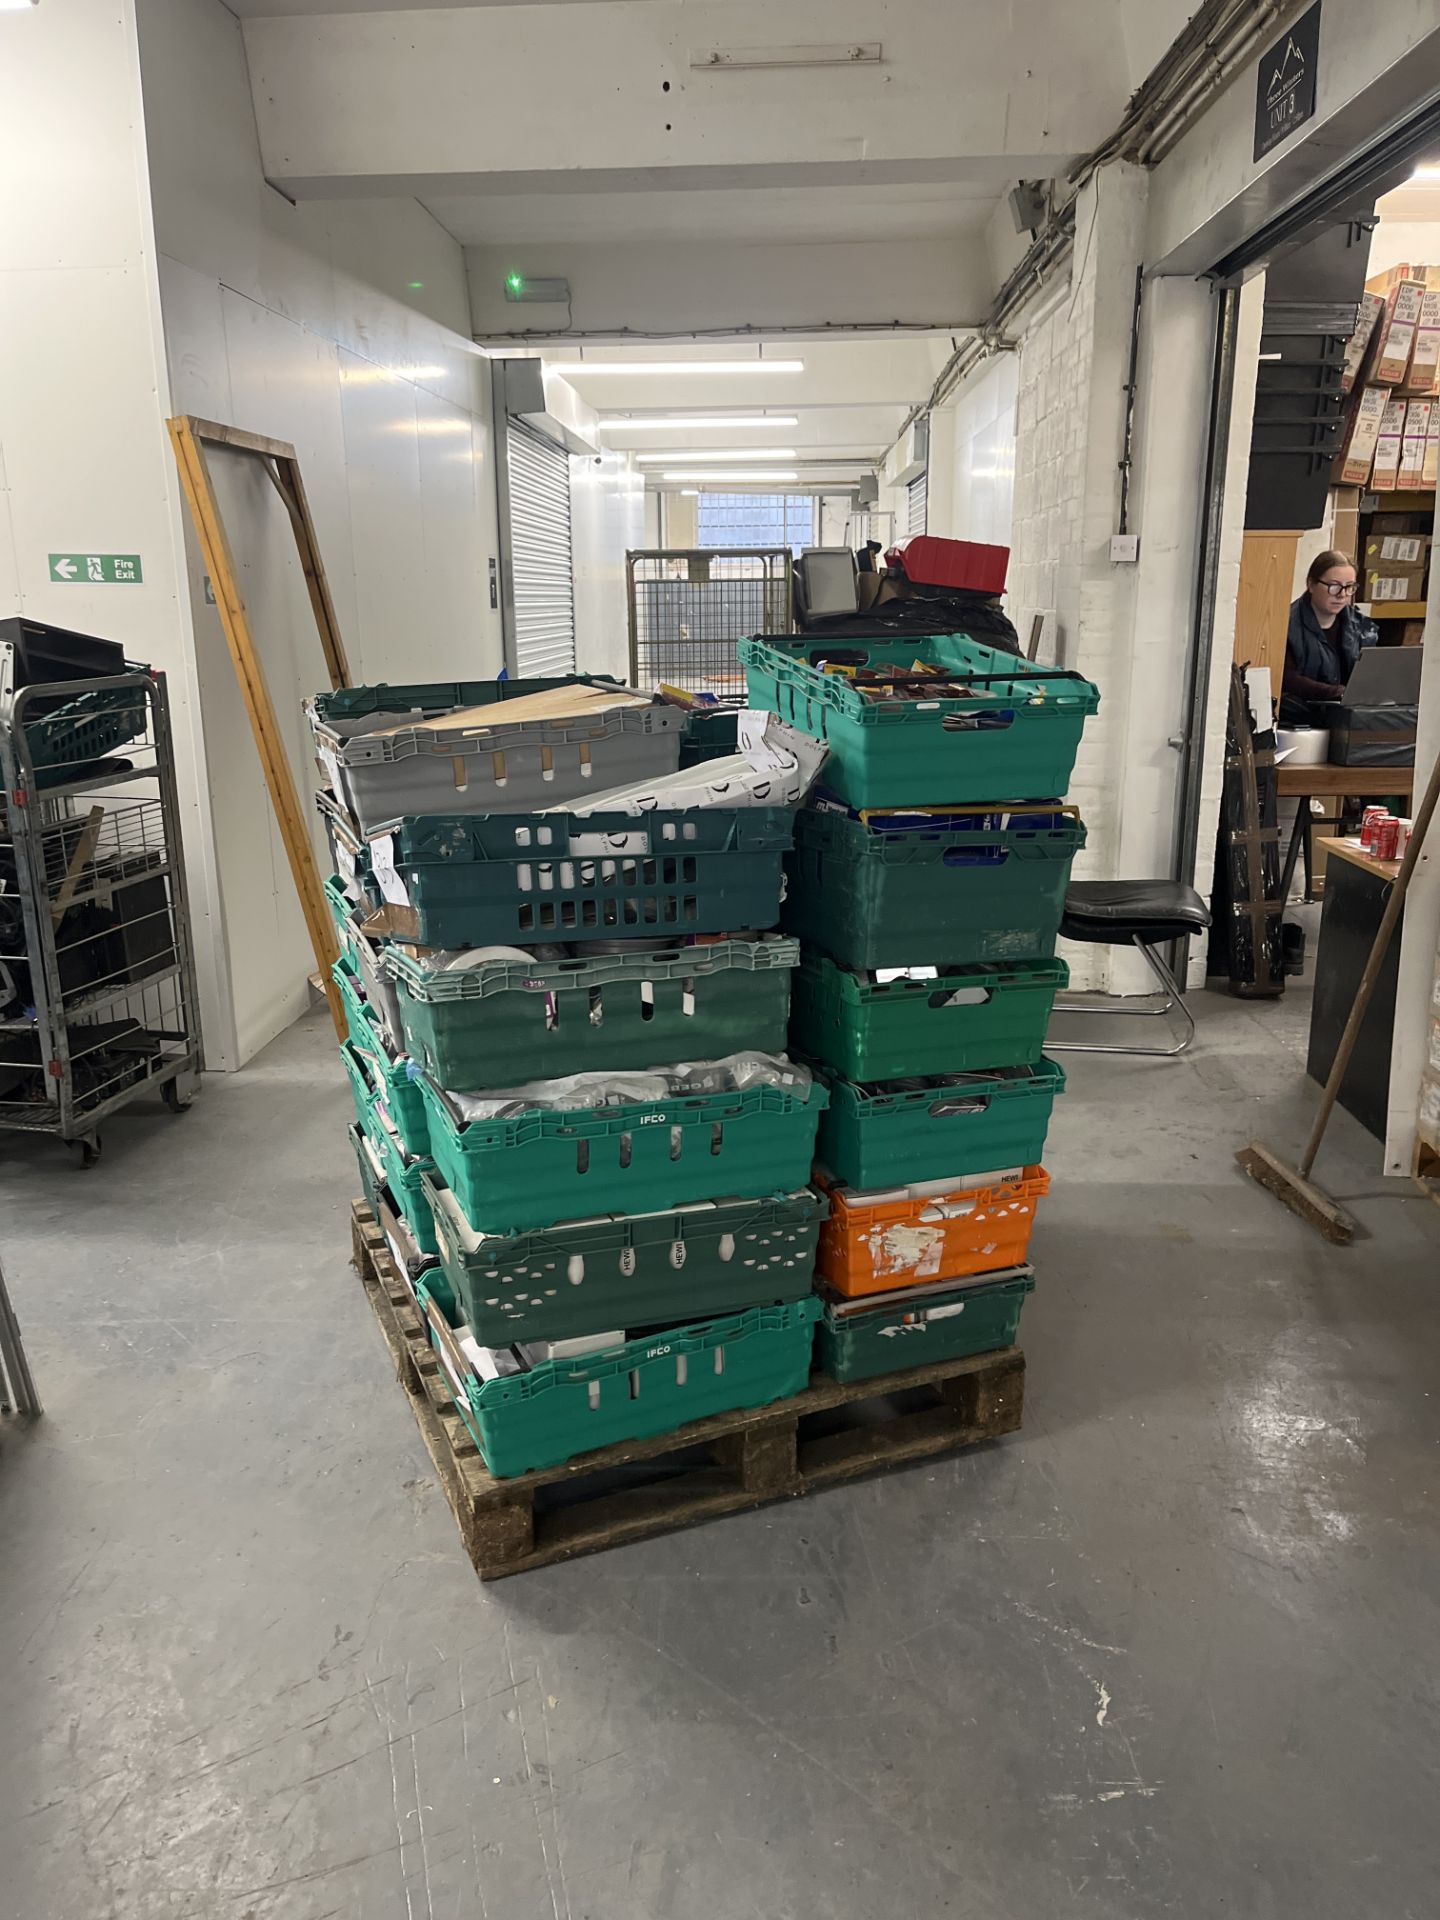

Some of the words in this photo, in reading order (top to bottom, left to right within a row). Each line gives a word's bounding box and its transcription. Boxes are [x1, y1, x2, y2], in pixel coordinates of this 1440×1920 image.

[1270, 99, 1288, 128] UNIT
[1289, 93, 1295, 114] 3
[113, 559, 134, 569] Fire
[115, 569, 135, 579] Exit
[639, 1113, 666, 1125] IFCO
[646, 1344, 671, 1359] IFCO
